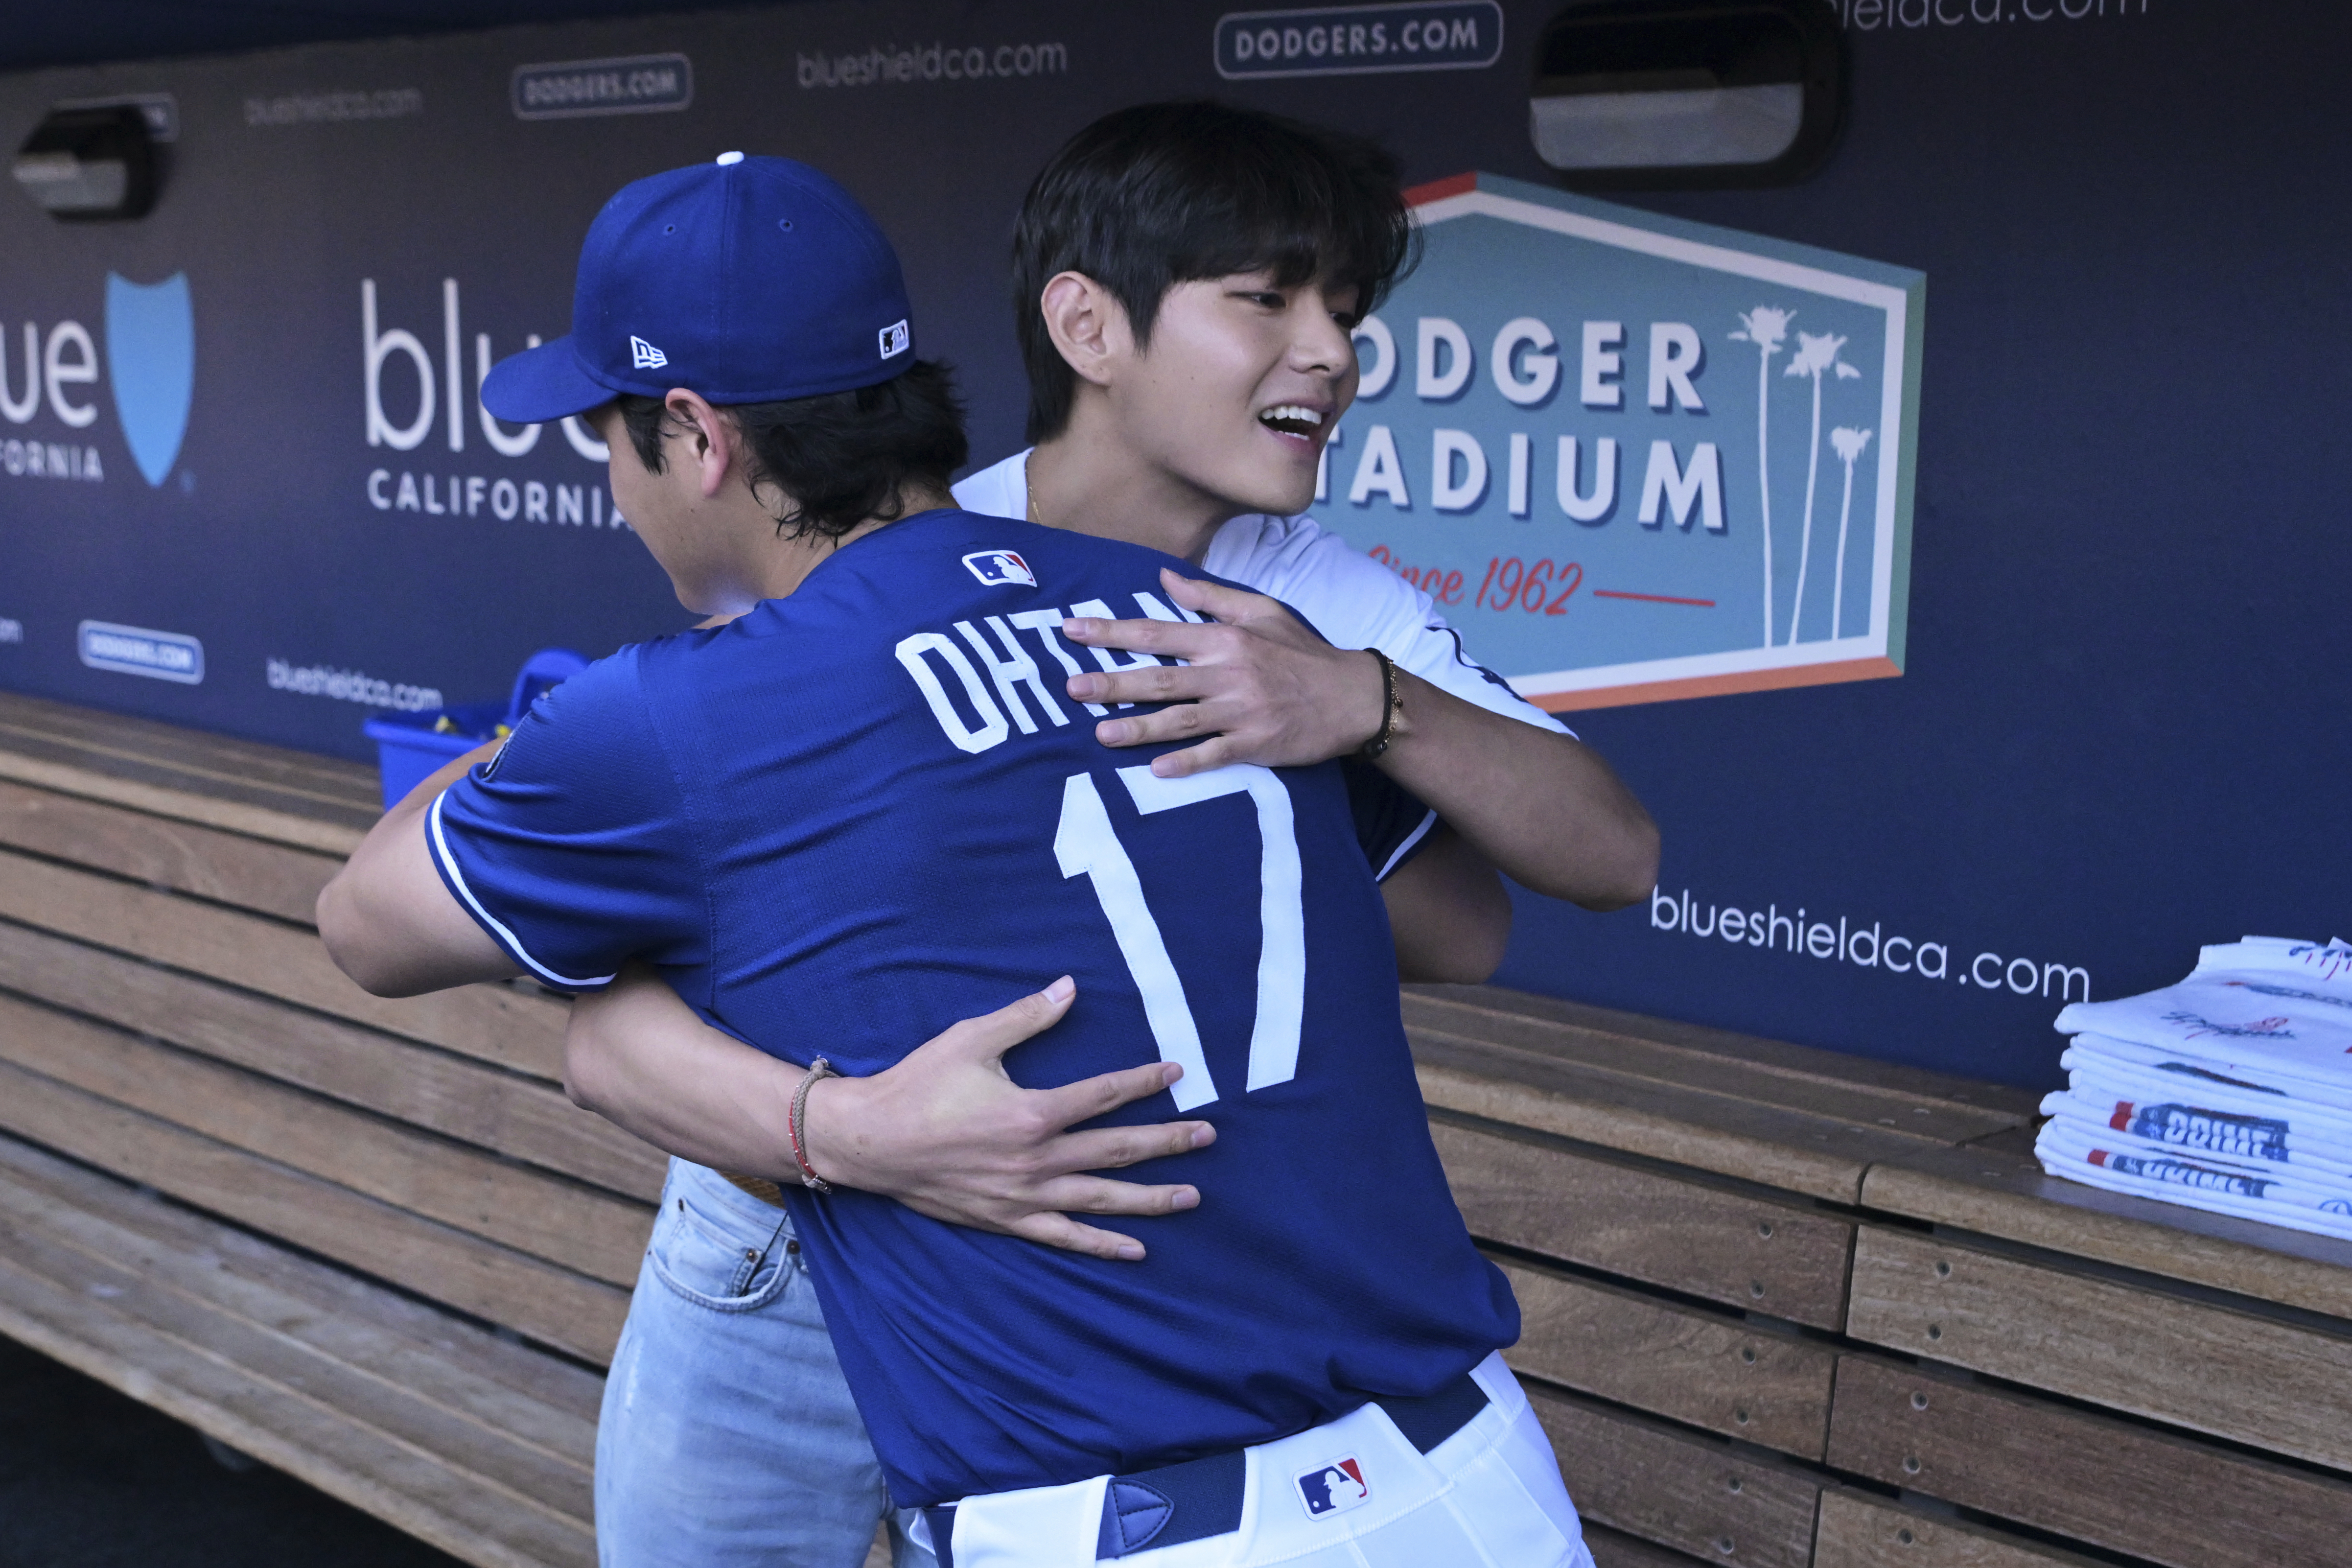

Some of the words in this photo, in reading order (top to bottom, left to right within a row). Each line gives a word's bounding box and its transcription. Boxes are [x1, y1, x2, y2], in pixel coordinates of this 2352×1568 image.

[1234, 18, 1478, 62] DODGERS.COM
[0, 438, 104, 483] ORNIA
[1475, 556, 1584, 616] 1962
[1053, 762, 1306, 1113] 17
[1651, 884, 2090, 1003] blueshieldca.com
